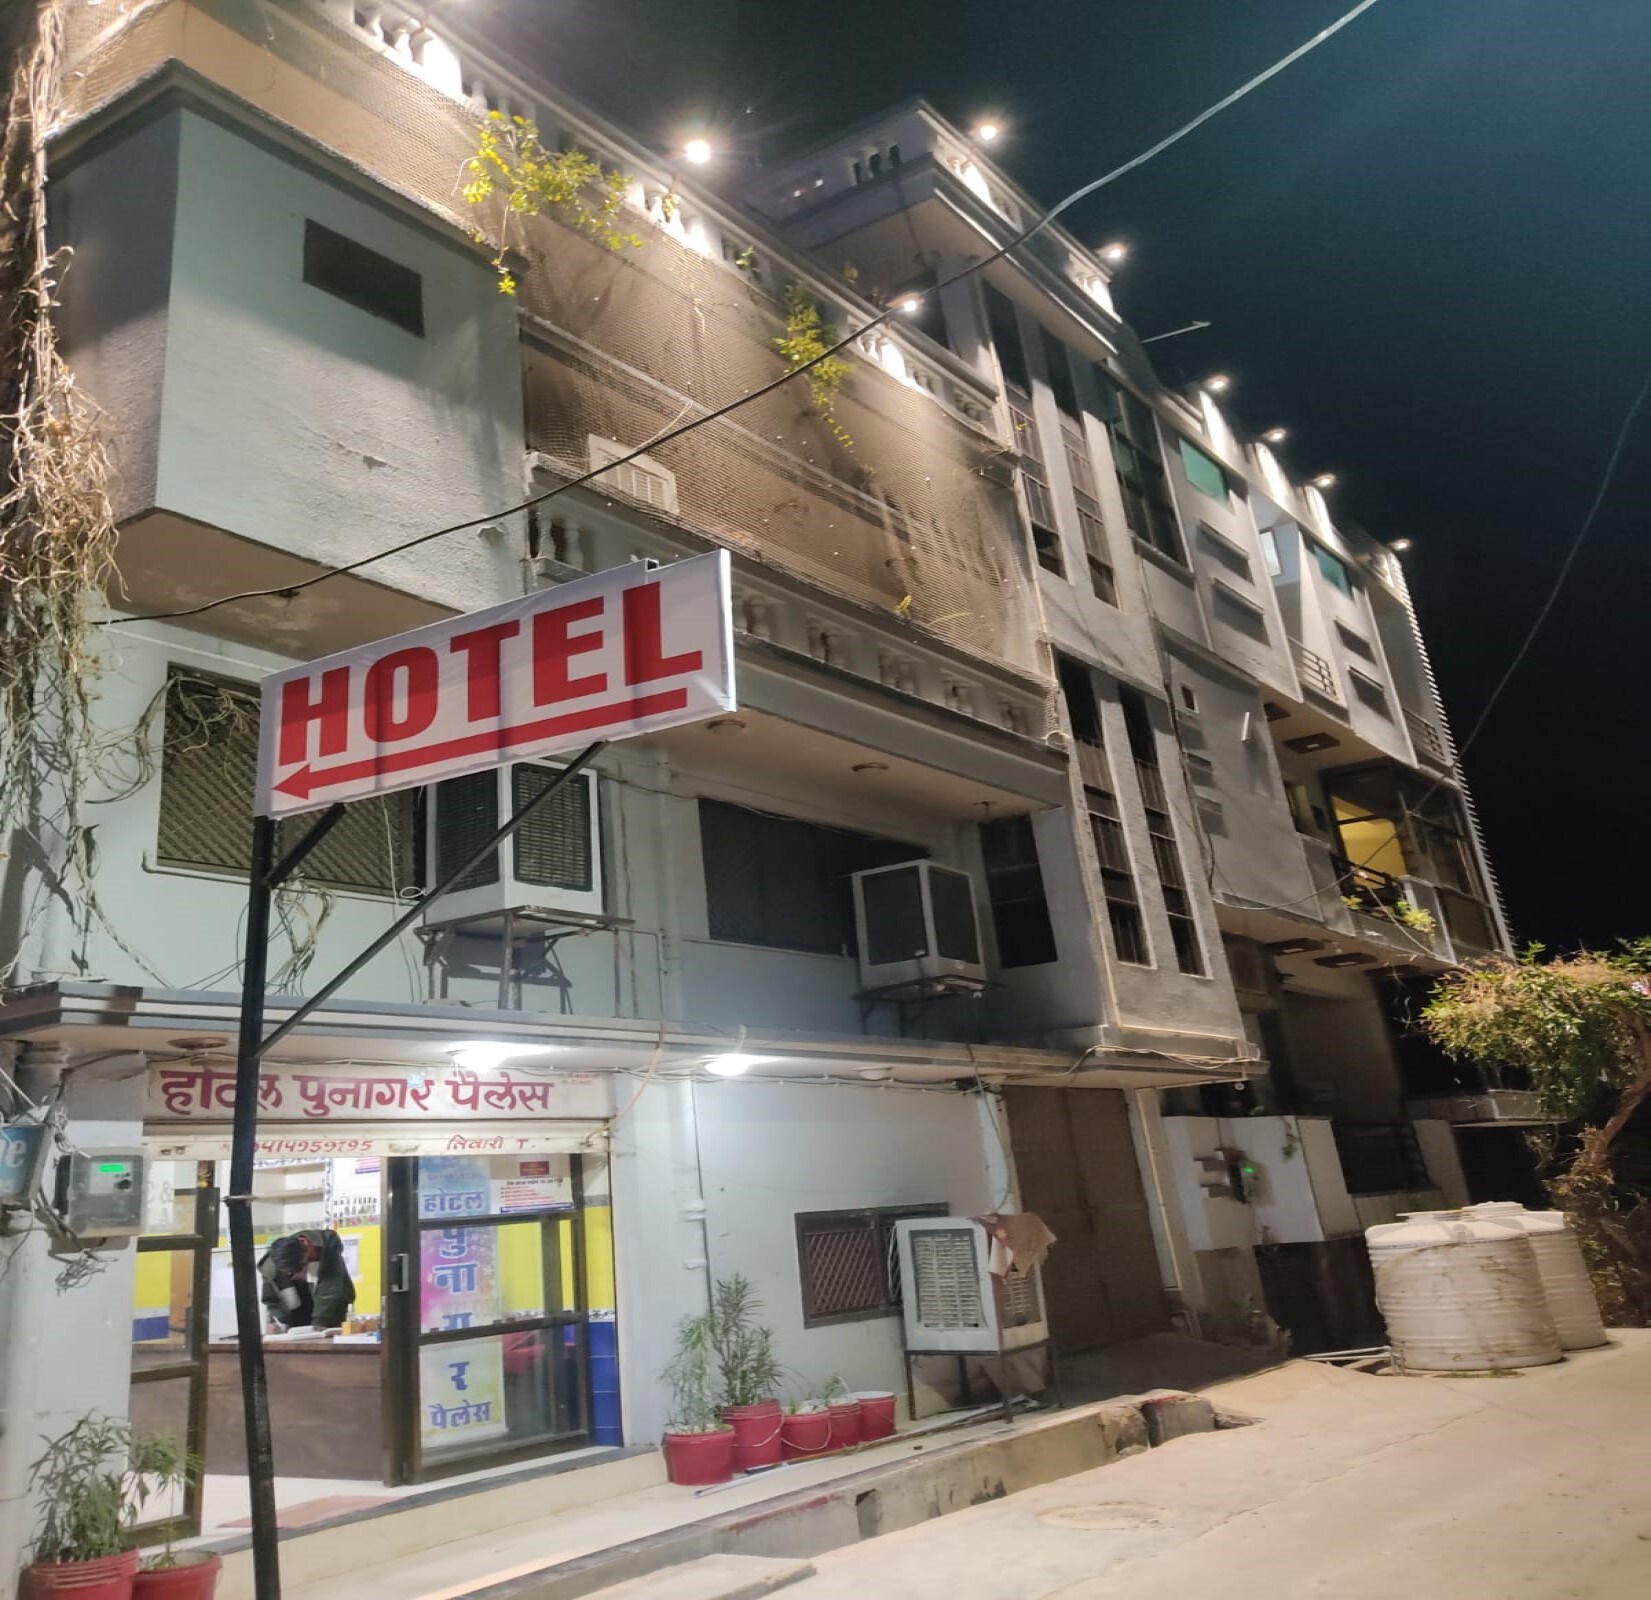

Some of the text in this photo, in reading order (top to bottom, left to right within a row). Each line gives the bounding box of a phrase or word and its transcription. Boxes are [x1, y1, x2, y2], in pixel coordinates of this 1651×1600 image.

[279, 581, 703, 766] HOTEL
[293, 1074, 435, 1117] पुनागर
[445, 1071, 555, 1111] पैलेस
[422, 1186, 485, 1212] होटल
[429, 1400, 493, 1429] पैलेस
